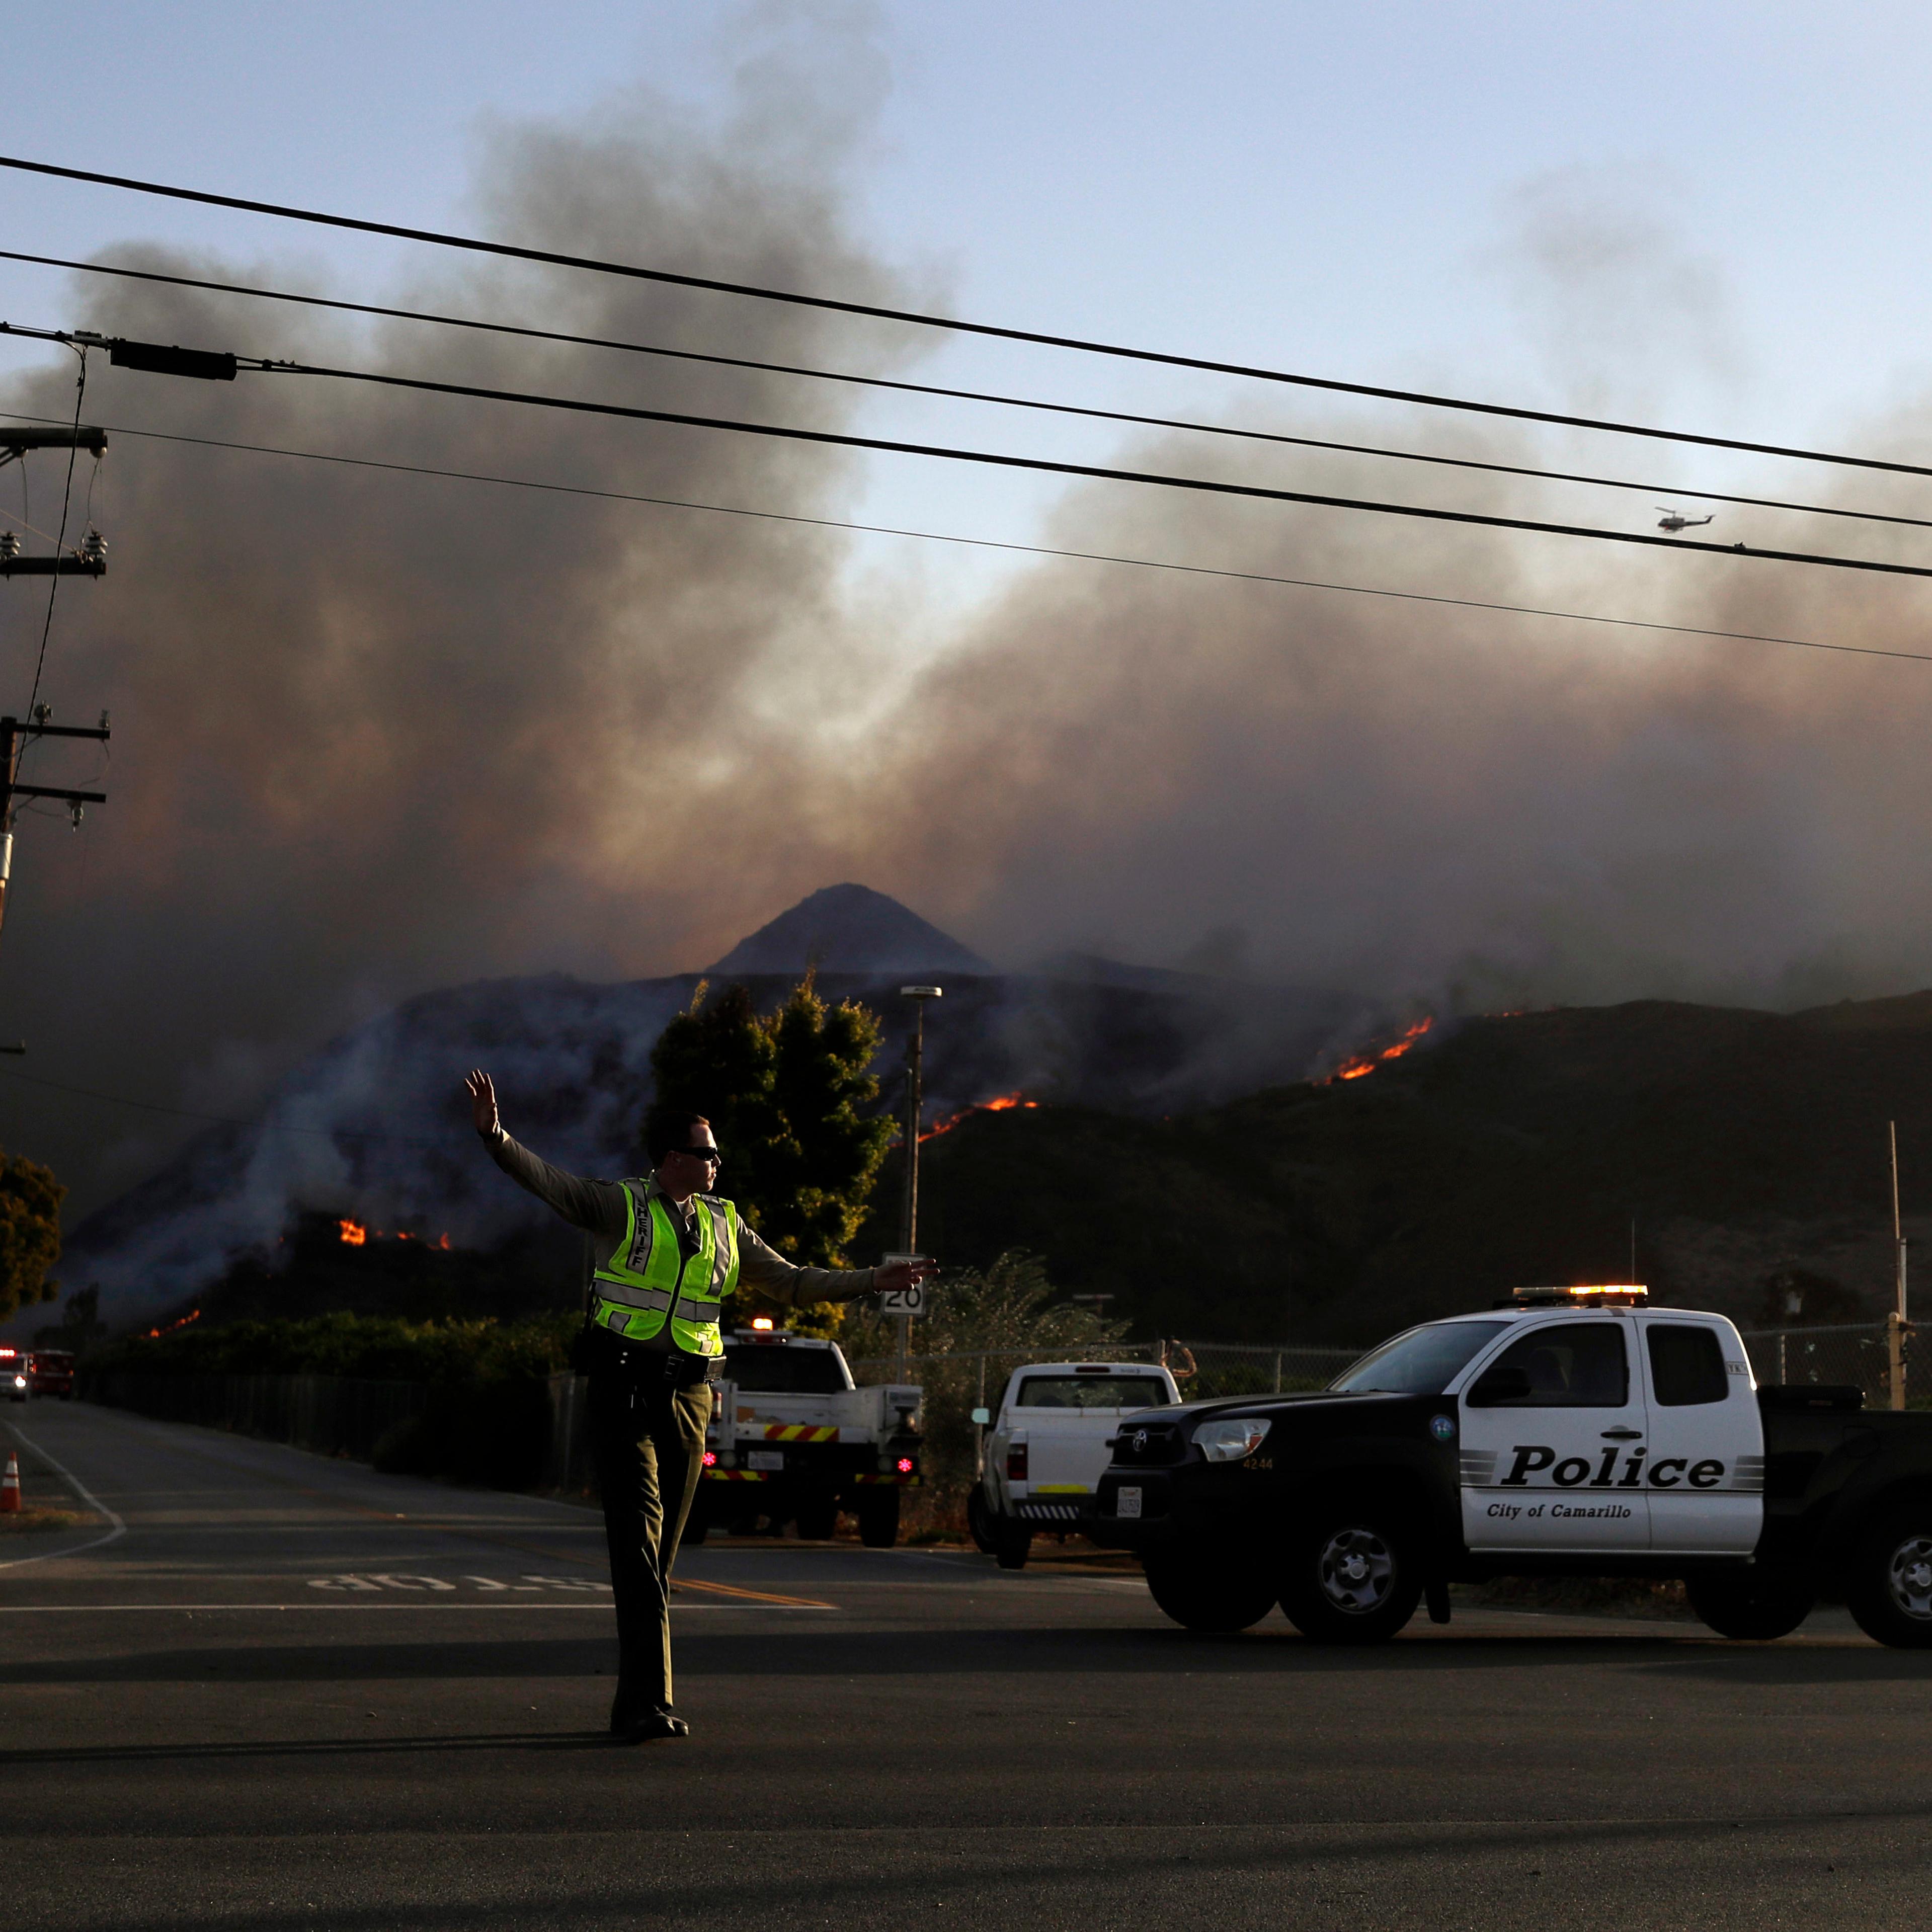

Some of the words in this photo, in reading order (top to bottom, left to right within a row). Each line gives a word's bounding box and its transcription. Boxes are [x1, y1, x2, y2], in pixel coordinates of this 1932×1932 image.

[887, 1286, 920, 1307] 20
[1243, 1458, 1272, 1469] 4244
[1500, 1445, 1725, 1488] Police
[1487, 1503, 1521, 1520] City
[1527, 1503, 1544, 1518] of
[1551, 1503, 1631, 1518] Camarillo
